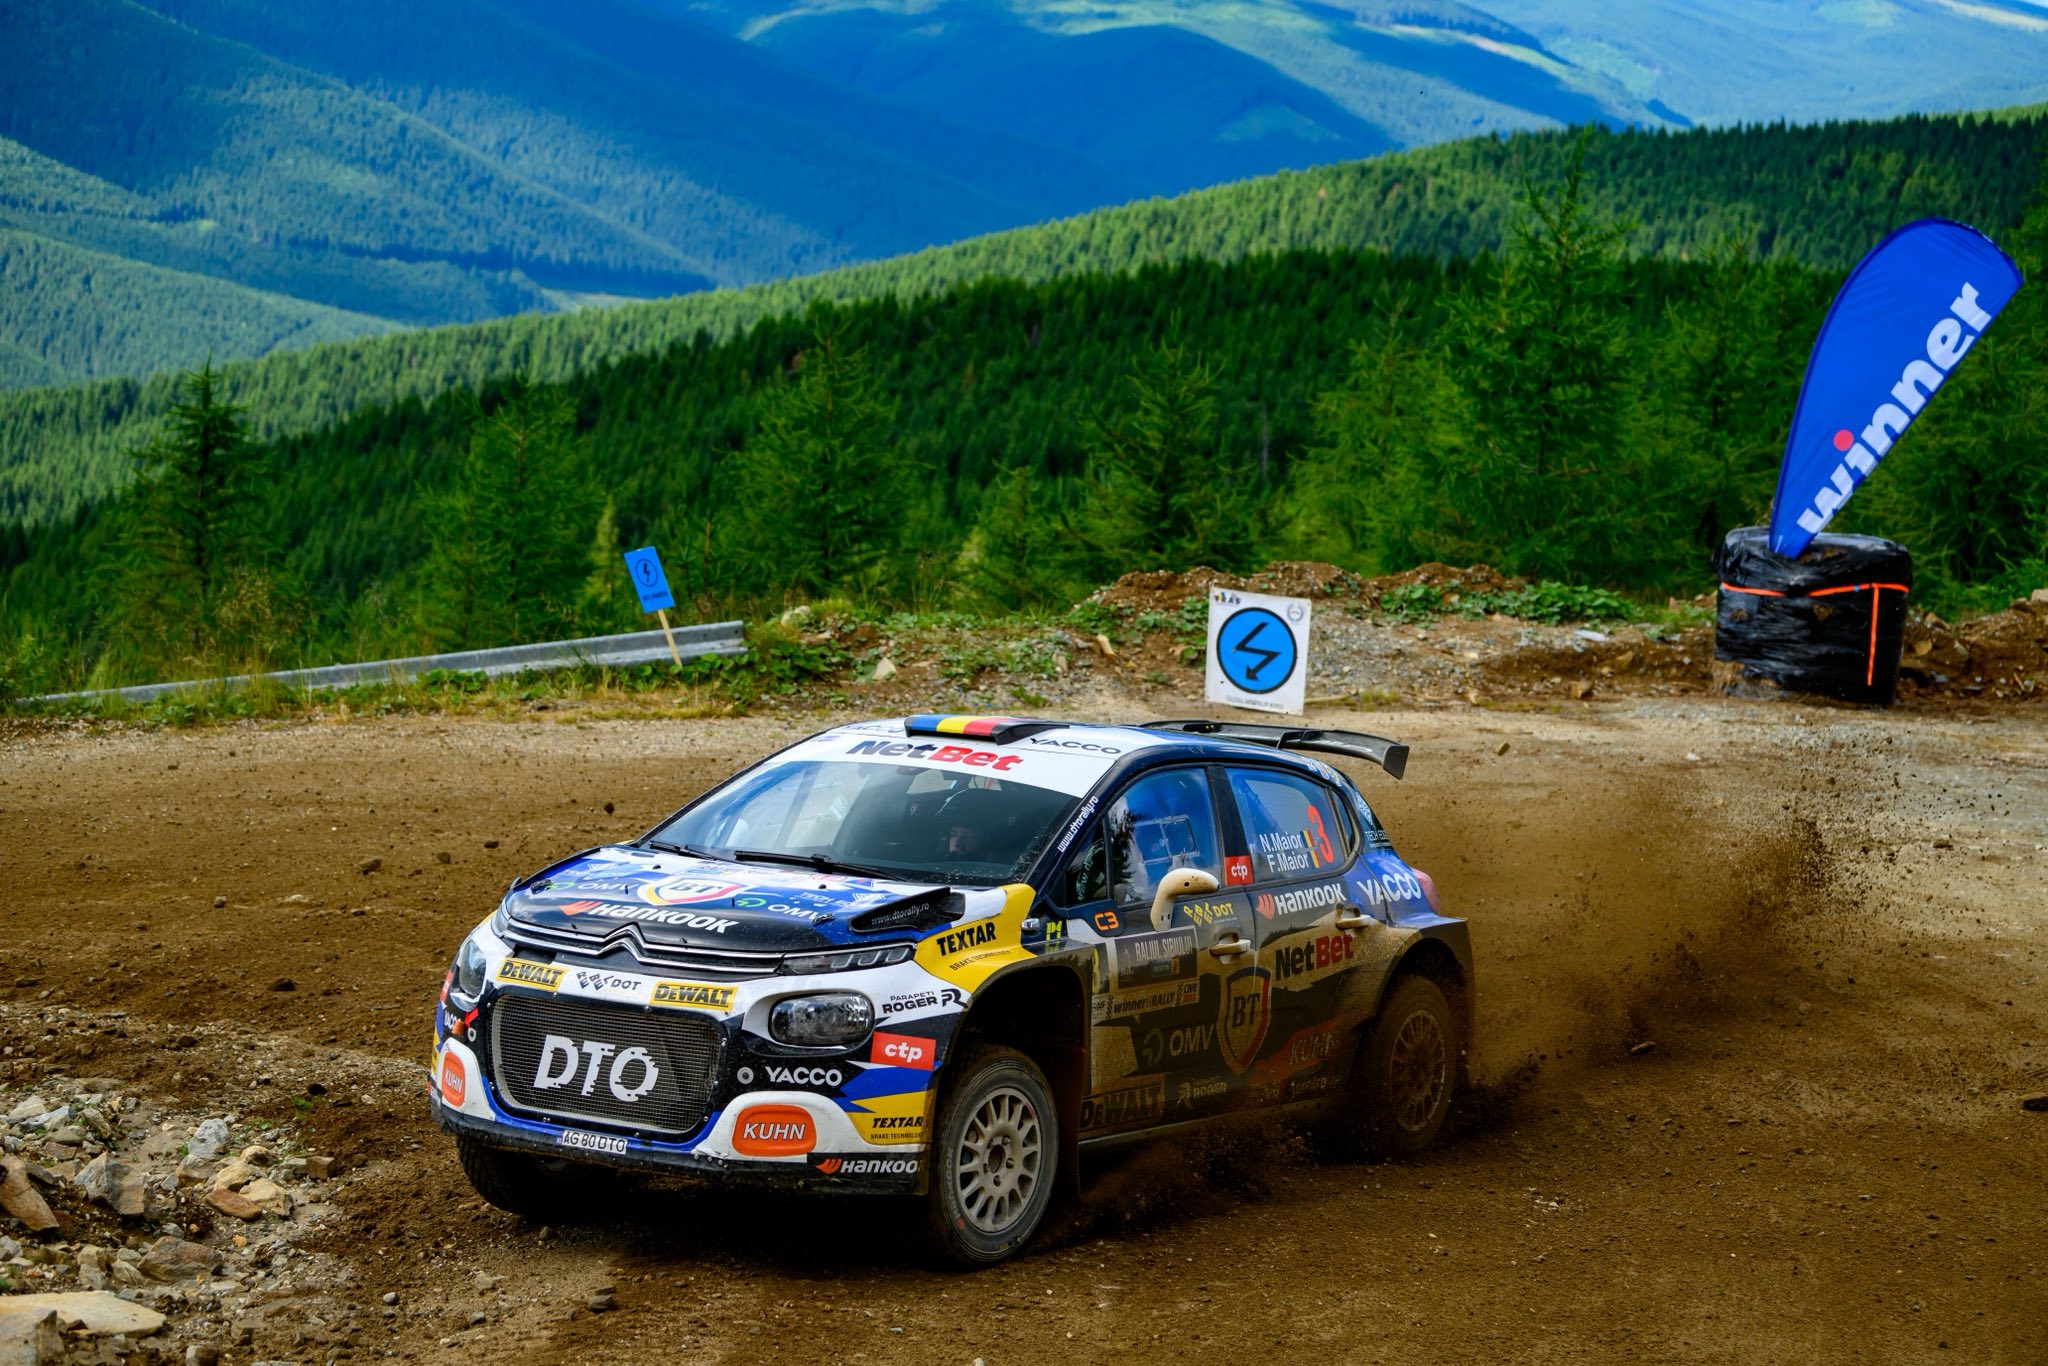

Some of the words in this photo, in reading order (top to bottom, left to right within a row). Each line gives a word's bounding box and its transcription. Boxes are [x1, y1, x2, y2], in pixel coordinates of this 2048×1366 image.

[1796, 281, 1992, 534] winner
[846, 740, 1024, 771] NetBet
[1030, 738, 1122, 755] YACCO
[1057, 795, 1099, 853] www.dtorally.ro
[1307, 804, 1334, 864] 3
[1259, 832, 1303, 853] N.Maior
[1231, 864, 1249, 879] ctp
[1267, 853, 1310, 874] F.Maior
[1356, 873, 1422, 906] YACCO
[871, 901, 930, 925] www.dtorally.ro
[1093, 911, 1119, 931] C3
[936, 922, 997, 956] TEXTAR
[1275, 933, 1354, 981] NetBet
[882, 996, 938, 1014] ROGER
[1232, 993, 1261, 1028] BT
[1169, 1024, 1215, 1056] OMV
[884, 1042, 922, 1063] ctp
[533, 1034, 659, 1102] DTO
[764, 1066, 842, 1087] YACCO
[445, 1068, 463, 1093] KUHN
[742, 1122, 805, 1141] KUHN
[872, 1116, 924, 1128] TEXTAR
[563, 1131, 579, 1146] AG
[581, 1133, 596, 1148] 80
[598, 1136, 626, 1153] DTO
